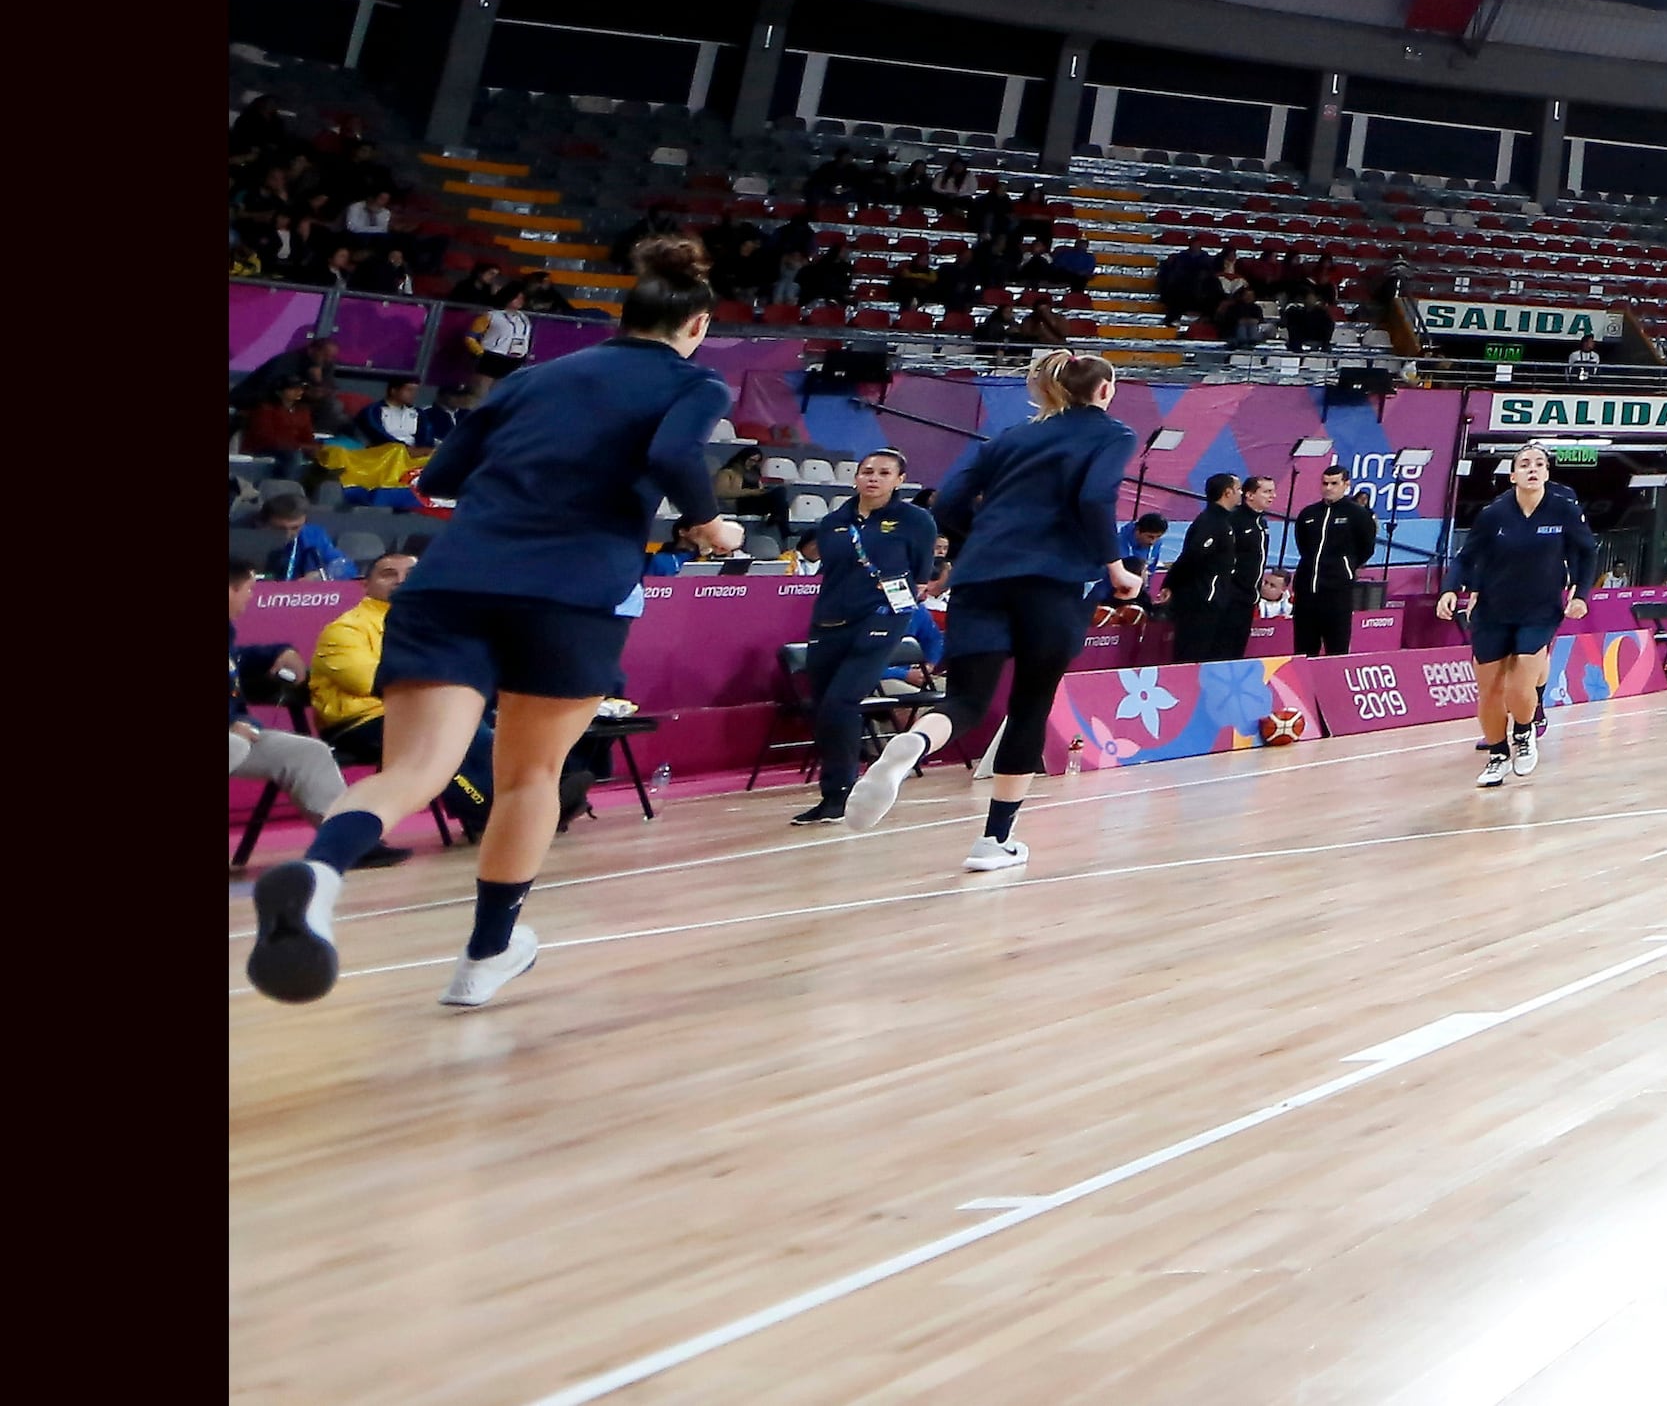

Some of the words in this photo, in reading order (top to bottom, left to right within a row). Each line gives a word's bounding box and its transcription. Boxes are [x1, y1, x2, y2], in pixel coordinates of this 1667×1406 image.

[1427, 305, 1593, 335] SALIDA
[1344, 482, 1420, 511] 019
[644, 587, 673, 599] 2019
[1422, 660, 1476, 686] PANAM
[1354, 690, 1408, 720] 2019
